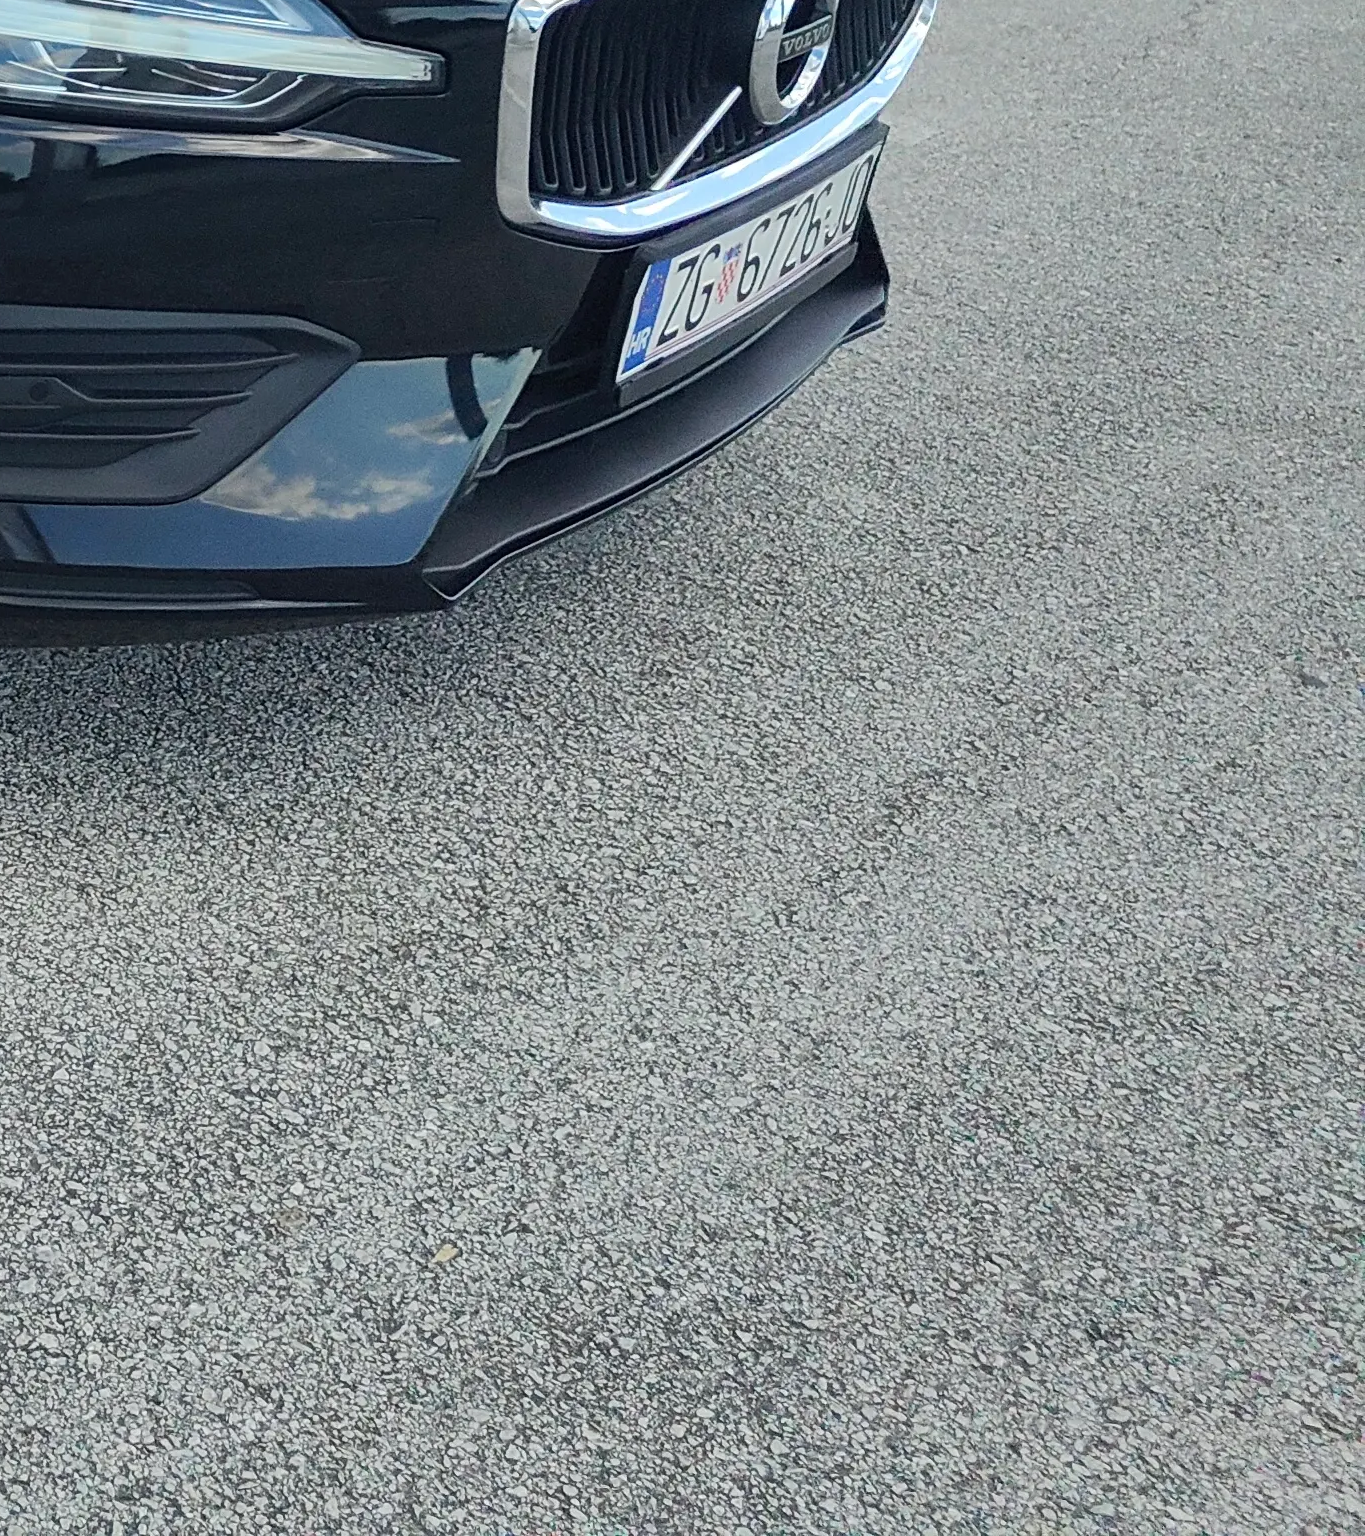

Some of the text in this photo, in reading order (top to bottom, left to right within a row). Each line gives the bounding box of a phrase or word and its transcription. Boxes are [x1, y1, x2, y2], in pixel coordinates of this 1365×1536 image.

[783, 23, 830, 56] VOLVO
[656, 243, 721, 347] ZG
[627, 327, 652, 357] HR
